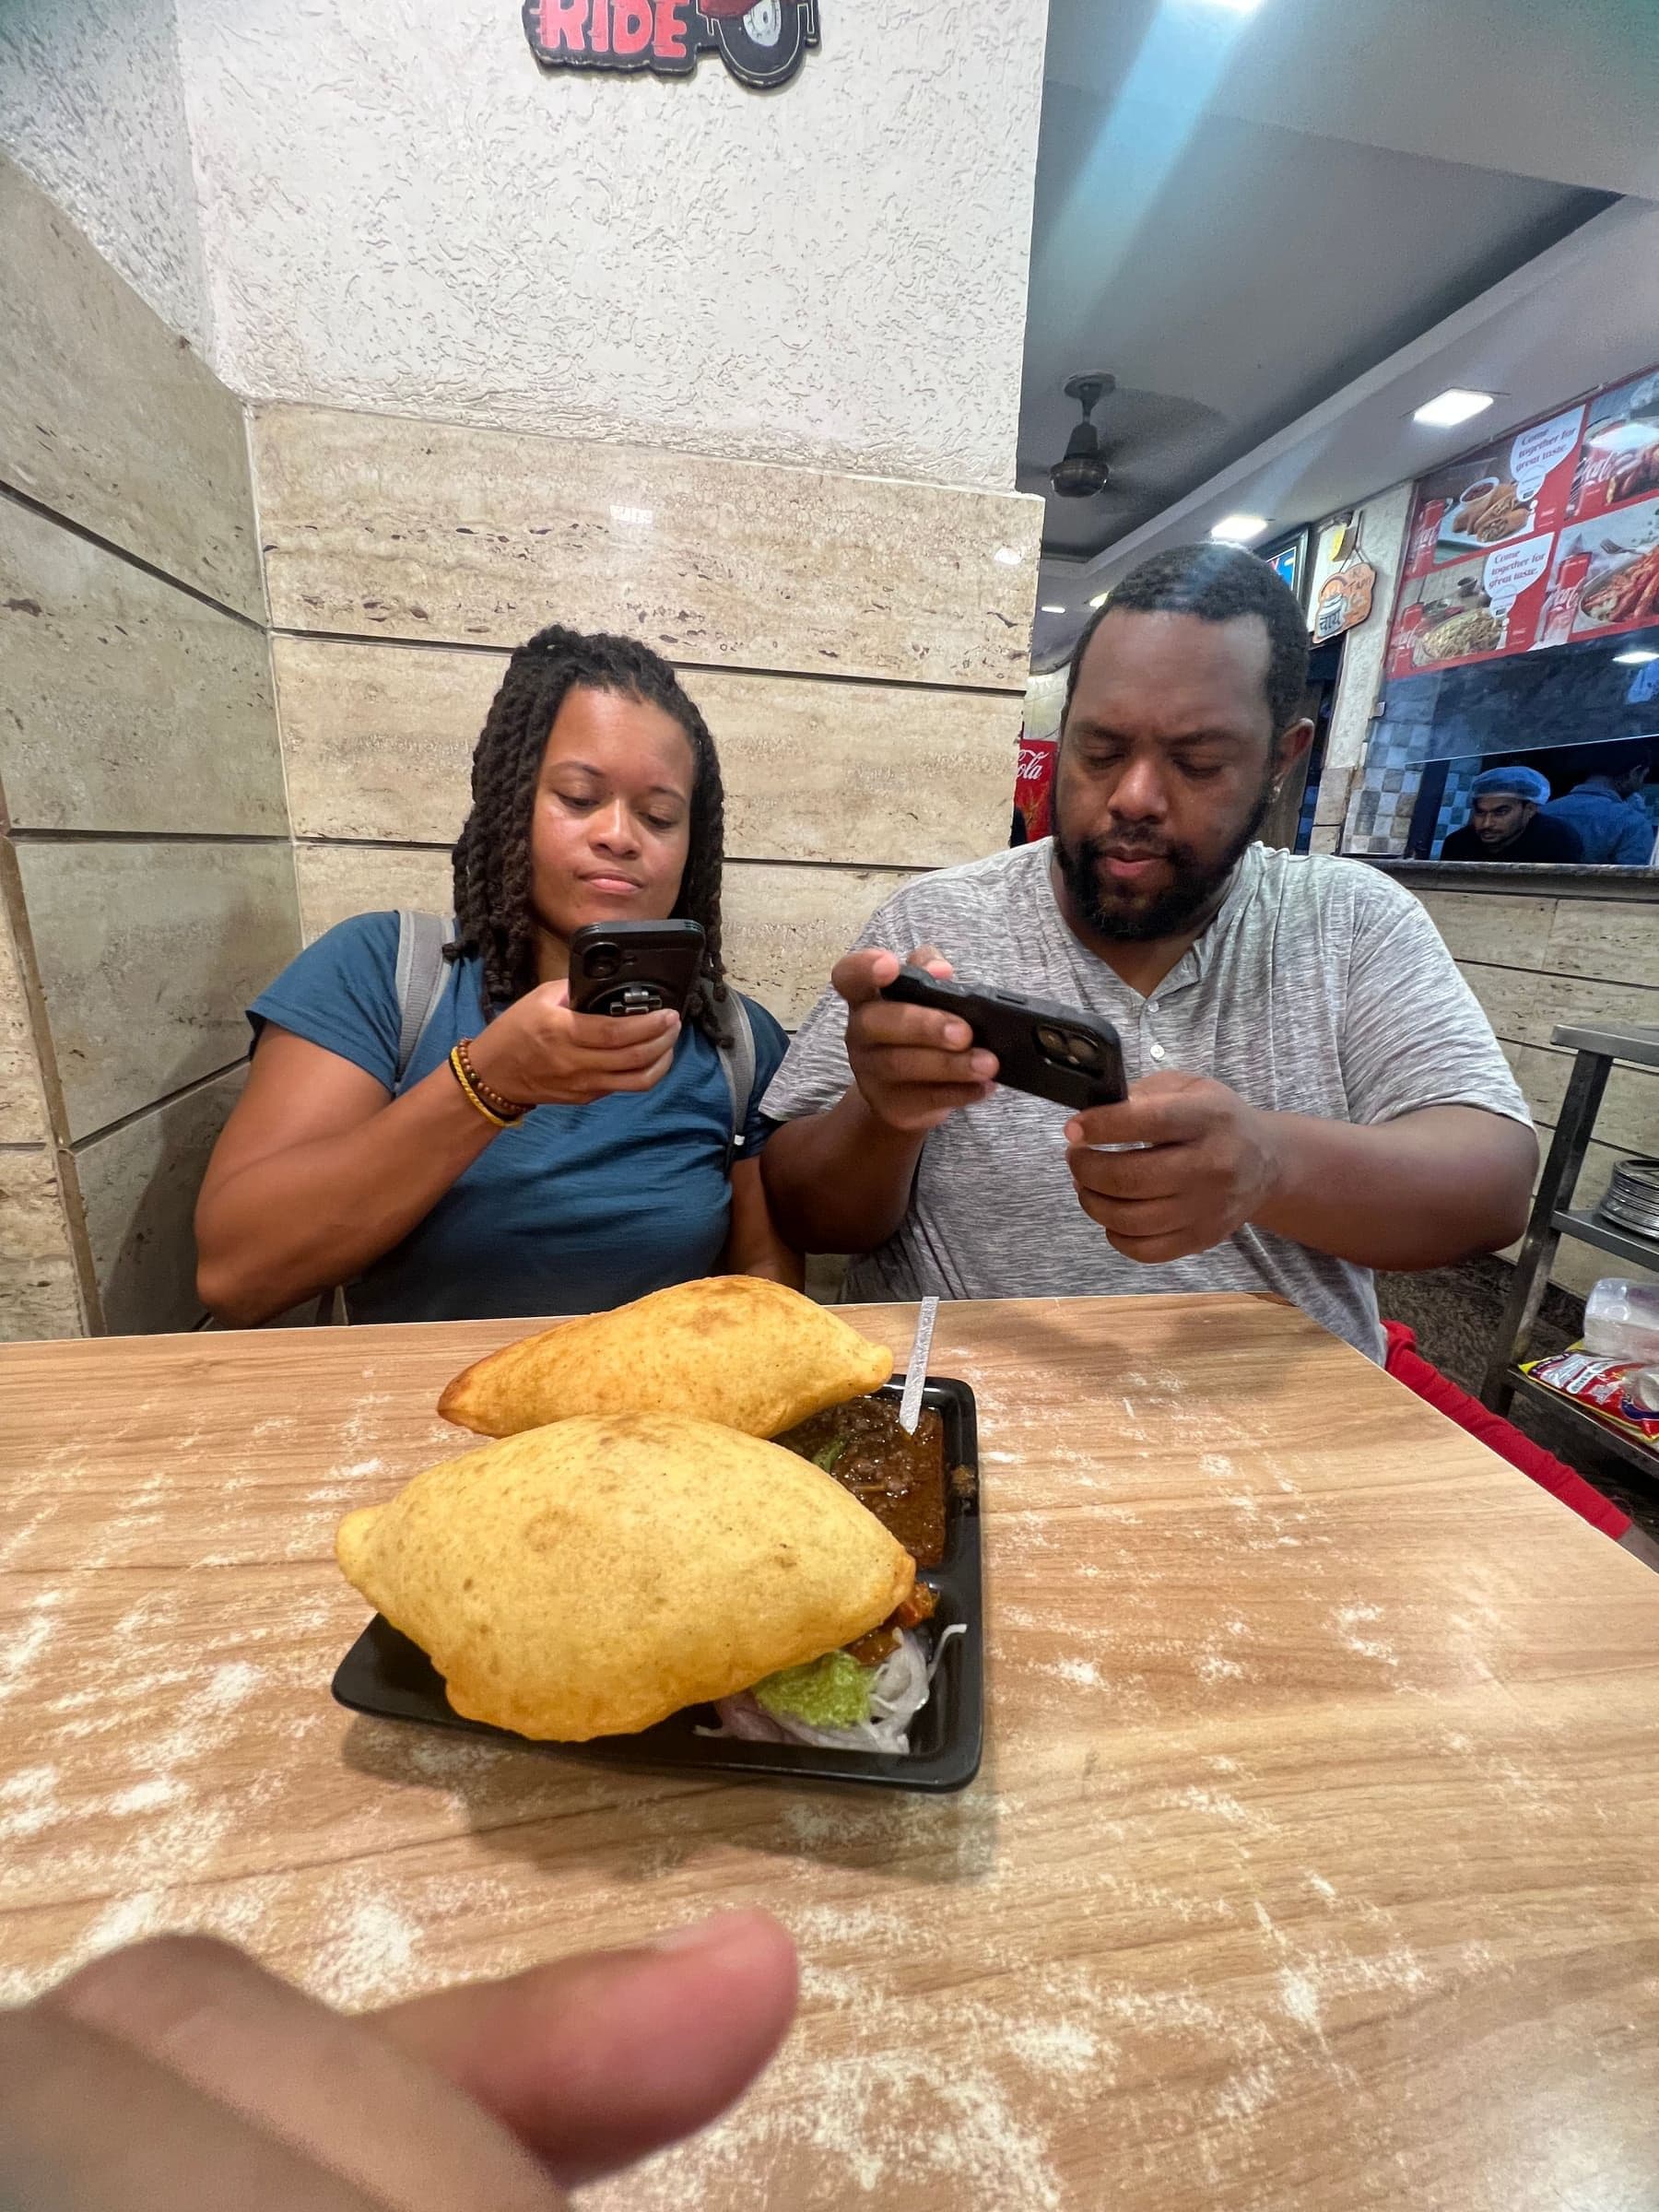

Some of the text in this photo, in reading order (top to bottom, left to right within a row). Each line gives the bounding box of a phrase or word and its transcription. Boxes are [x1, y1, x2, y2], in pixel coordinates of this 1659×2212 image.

[539, 0, 688, 58] RIDE
[1519, 435, 1560, 458] together
[1492, 553, 1546, 575] together for
[1495, 551, 1521, 563] Come
[1488, 575, 1512, 590] great
